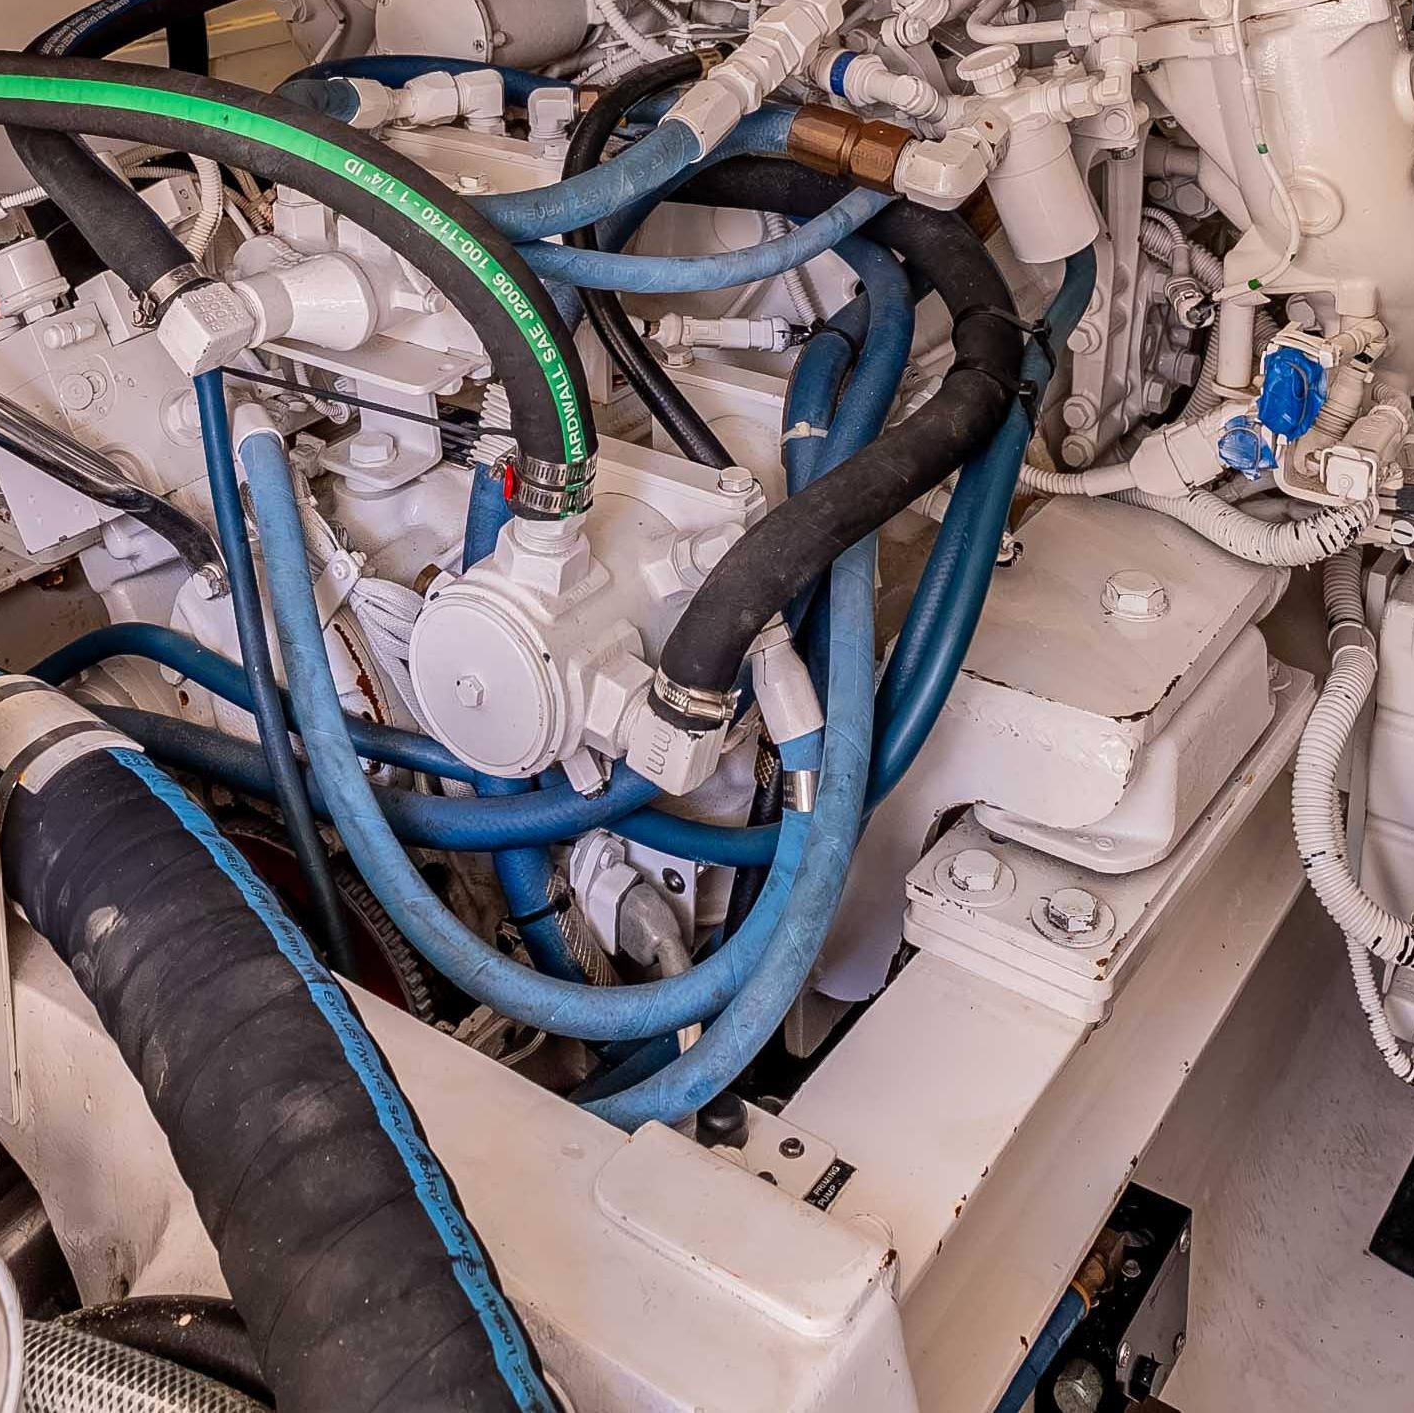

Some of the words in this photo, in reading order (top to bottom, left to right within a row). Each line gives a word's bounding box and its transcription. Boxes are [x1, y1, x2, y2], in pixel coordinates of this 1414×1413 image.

[343, 156, 362, 174] ID
[421, 206, 490, 270] 100-1140
[492, 272, 535, 322] J2006
[528, 322, 558, 364] SAE
[550, 363, 586, 464] HARDWALL
